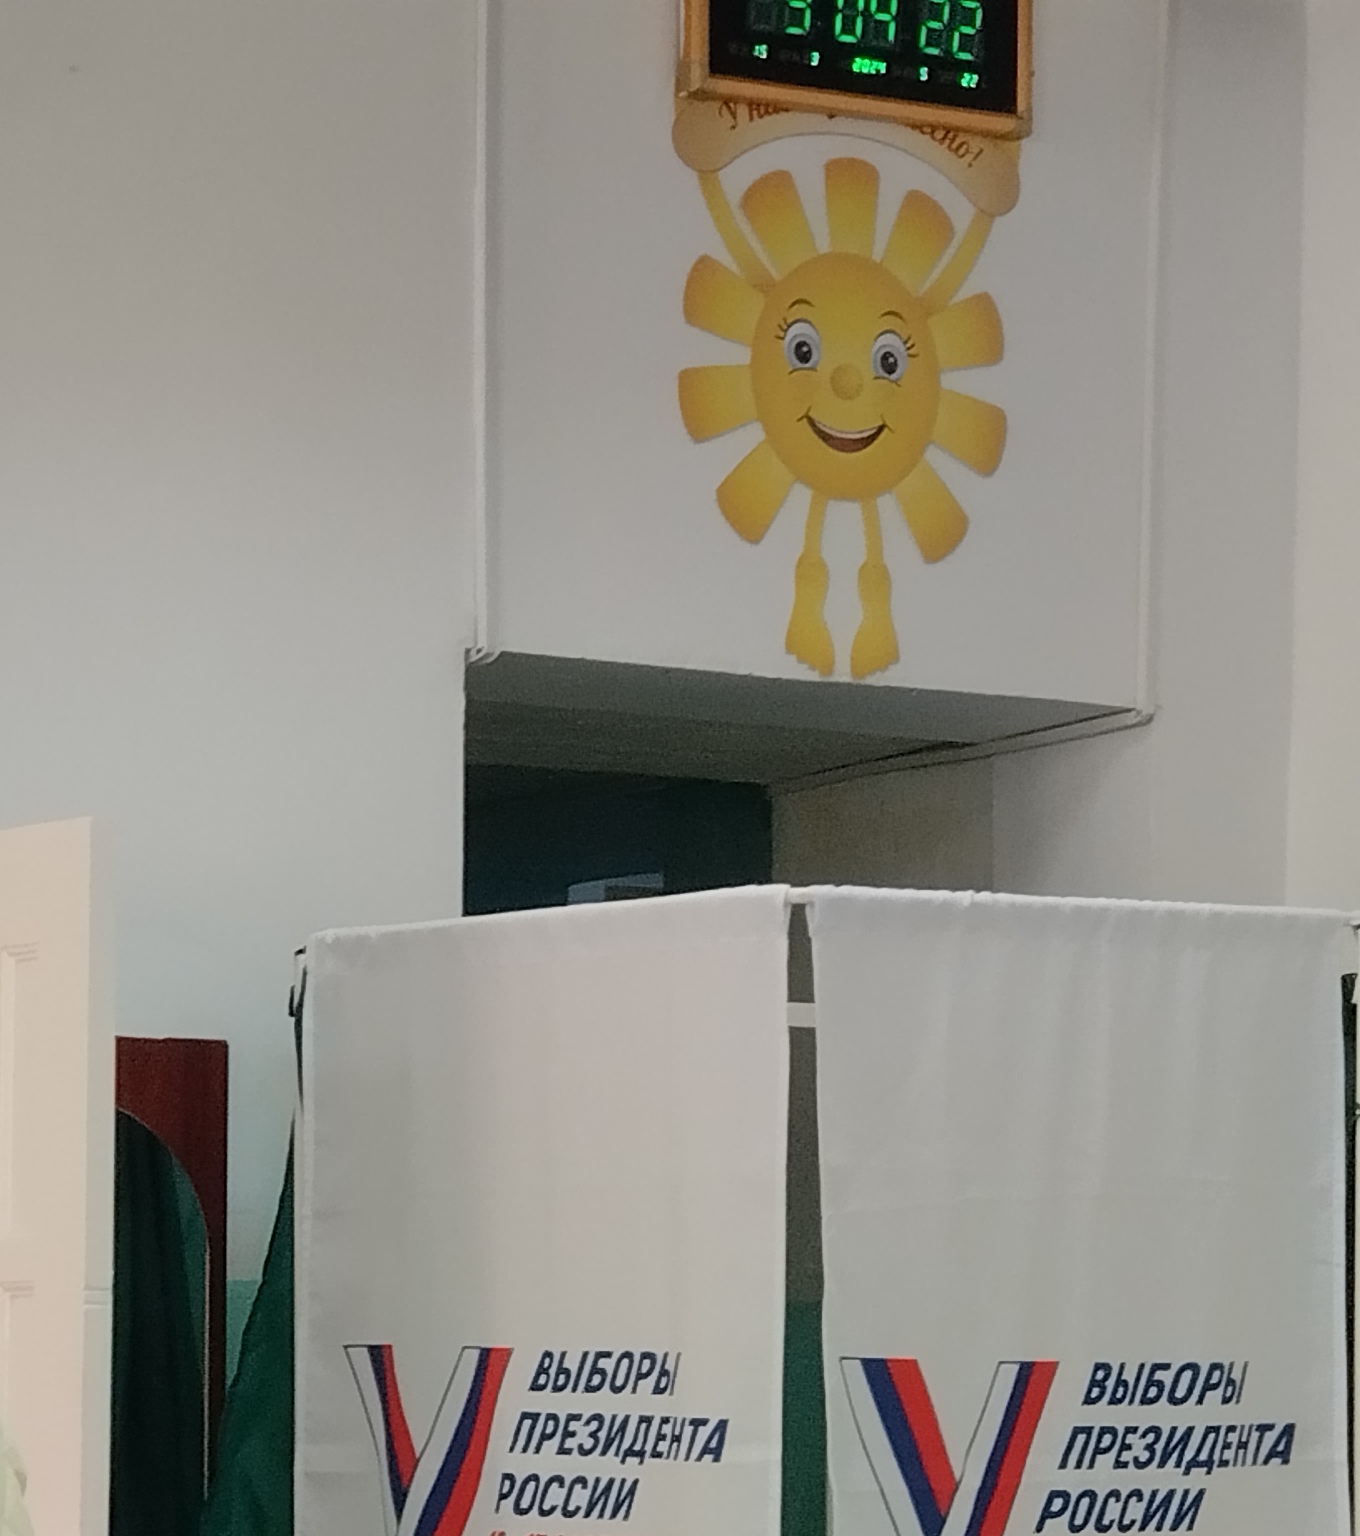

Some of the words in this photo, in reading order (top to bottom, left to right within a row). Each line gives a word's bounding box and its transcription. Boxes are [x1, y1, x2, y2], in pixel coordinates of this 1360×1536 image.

[852, 57, 887, 74] 2024
[528, 1350, 682, 1396] ВЫБОРЫ
[1081, 1361, 1249, 1406] ВЫБОРЫ
[508, 1411, 729, 1465] ПРЕЗИДЕНТА
[1058, 1423, 1296, 1476] ПРЕЗИДЕНТА
[495, 1472, 639, 1521] РОССИИ
[1033, 1488, 1206, 1534] РОССИИ
